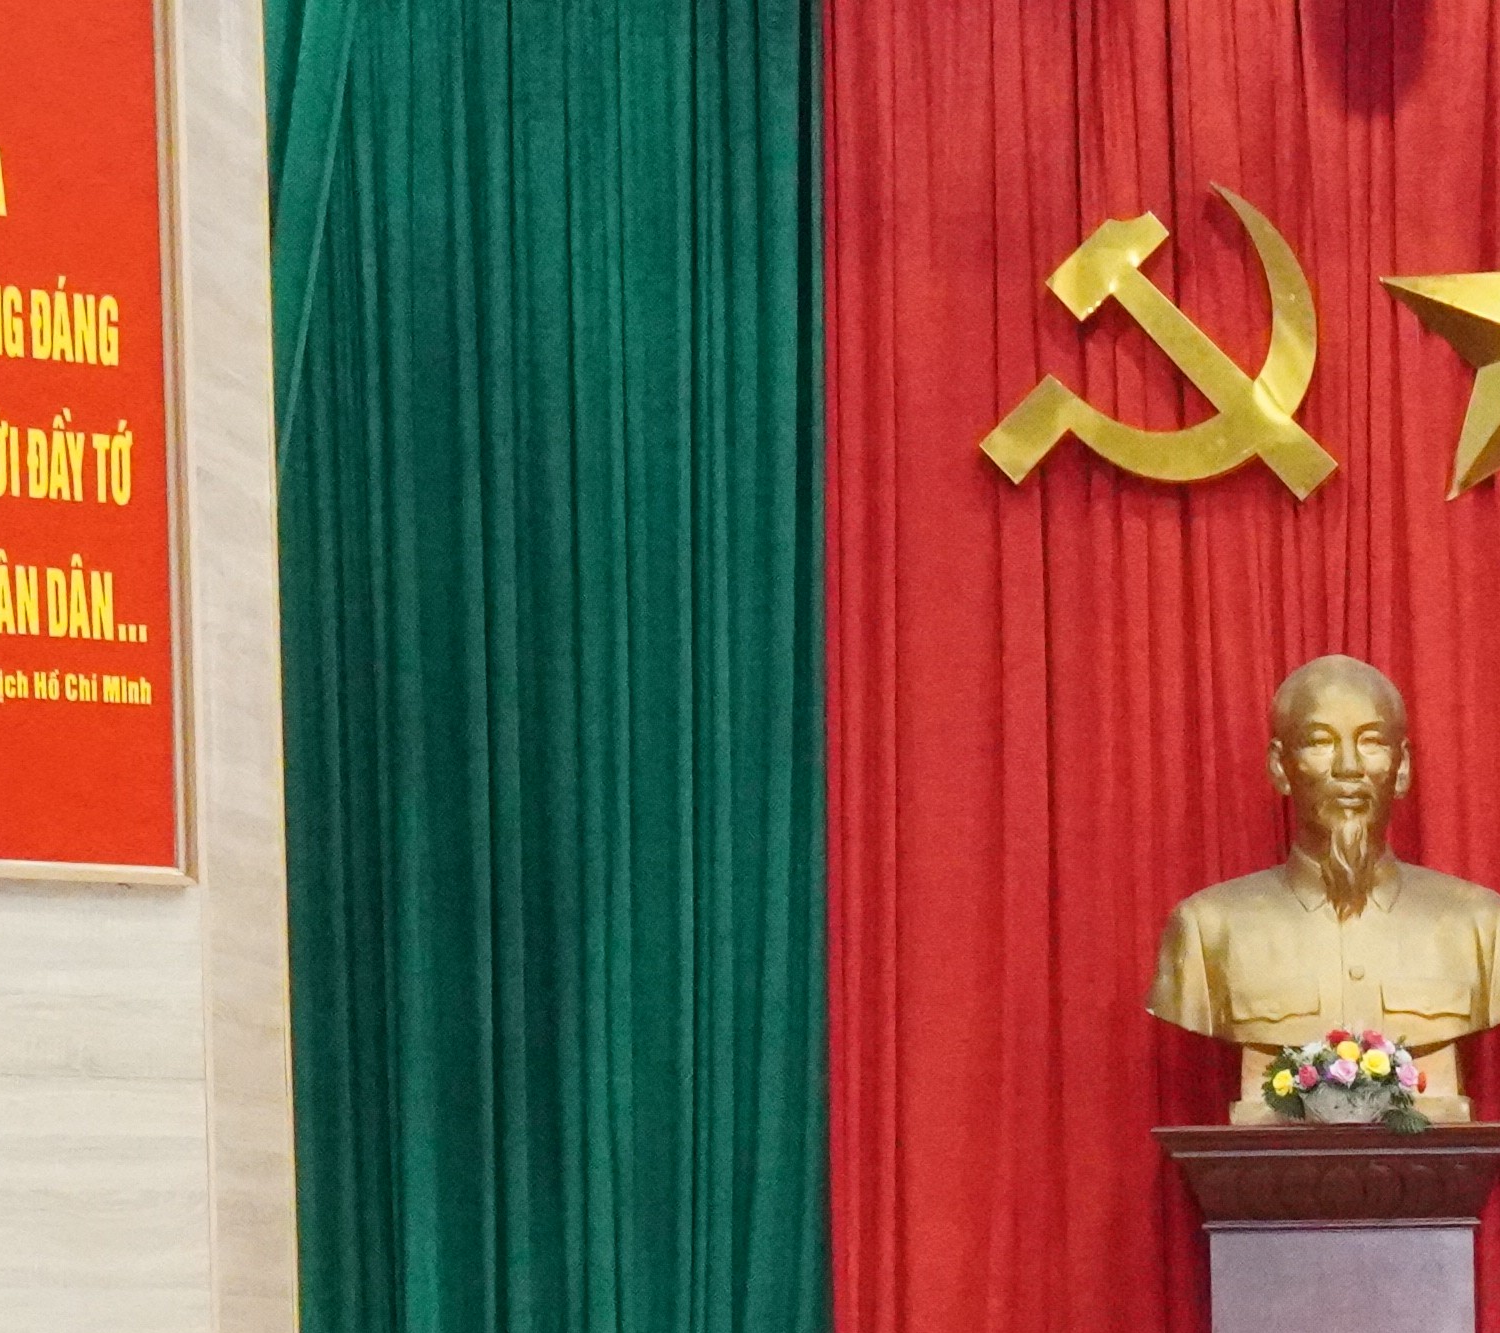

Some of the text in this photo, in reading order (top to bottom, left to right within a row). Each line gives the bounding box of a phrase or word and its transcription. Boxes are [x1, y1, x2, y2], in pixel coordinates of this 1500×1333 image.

[30, 275, 119, 367] ĐÁNG
[26, 407, 85, 502] ĐẦY
[92, 419, 133, 506] TỚ
[46, 553, 147, 642] DÂN...
[33, 669, 60, 700] Hồ
[102, 675, 152, 705] Minh
